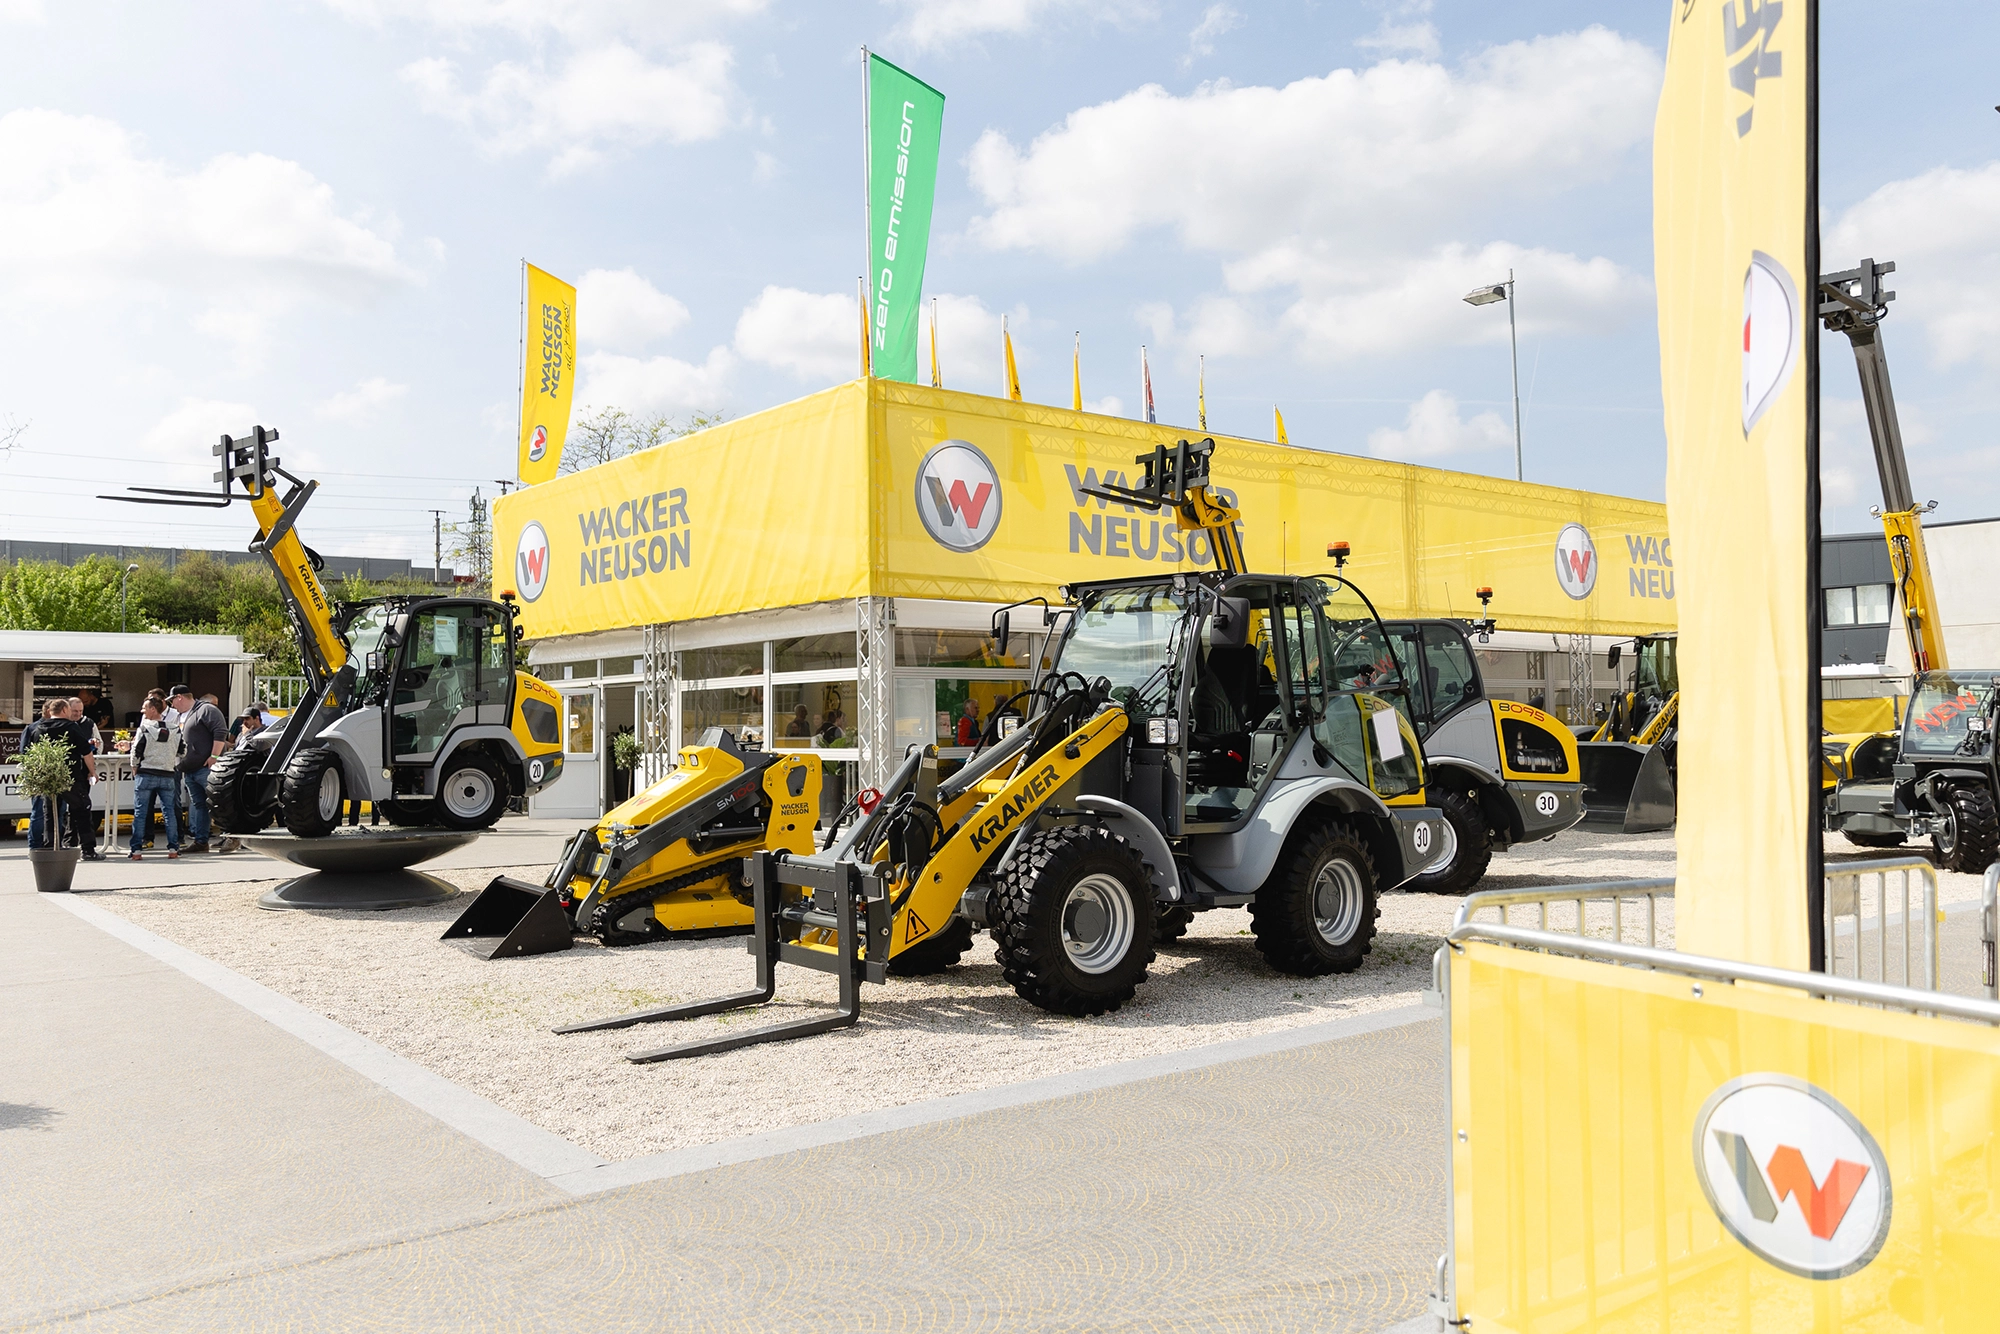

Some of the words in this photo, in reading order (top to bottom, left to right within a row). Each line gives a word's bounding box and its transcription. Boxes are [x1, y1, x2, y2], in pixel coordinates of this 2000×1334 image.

[876, 268, 892, 350] zero
[884, 100, 915, 262] emission
[540, 303, 553, 393] WACKER
[550, 306, 562, 399] NEUSON
[578, 487, 690, 546] WACKER
[1069, 511, 1244, 566] NEUSO
[1625, 534, 1673, 567] WAC
[580, 529, 690, 587] NEUSON
[298, 564, 324, 612] KRAMER
[1629, 567, 1675, 600] NEU
[523, 680, 557, 700] 5040
[1498, 703, 1545, 722] 8095
[1914, 691, 1977, 733] NEW
[533, 764, 541, 778] 20
[716, 781, 757, 810] SM100
[780, 802, 809, 810] WACKER
[781, 808, 809, 816] NEUSON
[969, 764, 1060, 853] KRAMER
[1540, 796, 1554, 810] 30
[1416, 827, 1428, 847] 30
